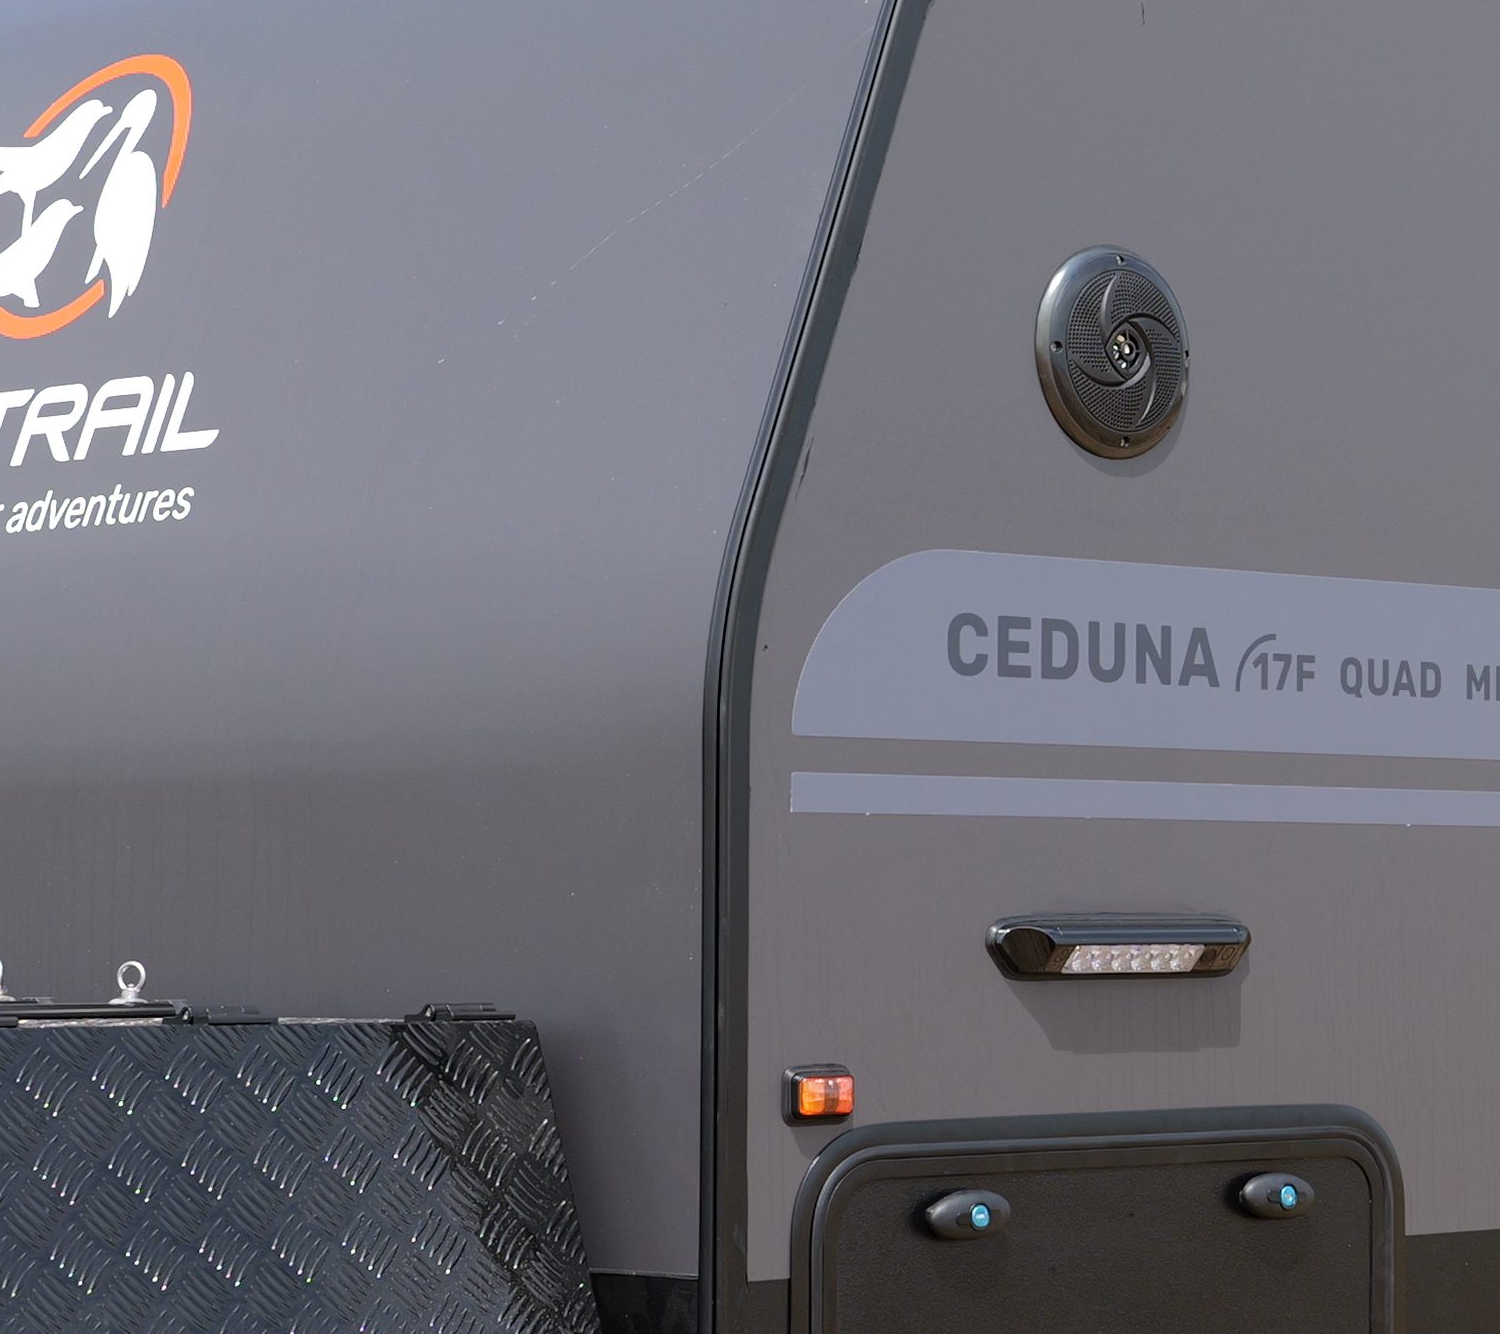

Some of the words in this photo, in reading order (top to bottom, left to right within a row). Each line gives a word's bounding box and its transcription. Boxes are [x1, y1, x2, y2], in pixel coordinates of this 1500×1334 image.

[5, 484, 196, 535] adventures
[947, 613, 1222, 689] CEDUNA
[1252, 652, 1317, 693] 17F
[1340, 657, 1444, 700] QUAD
